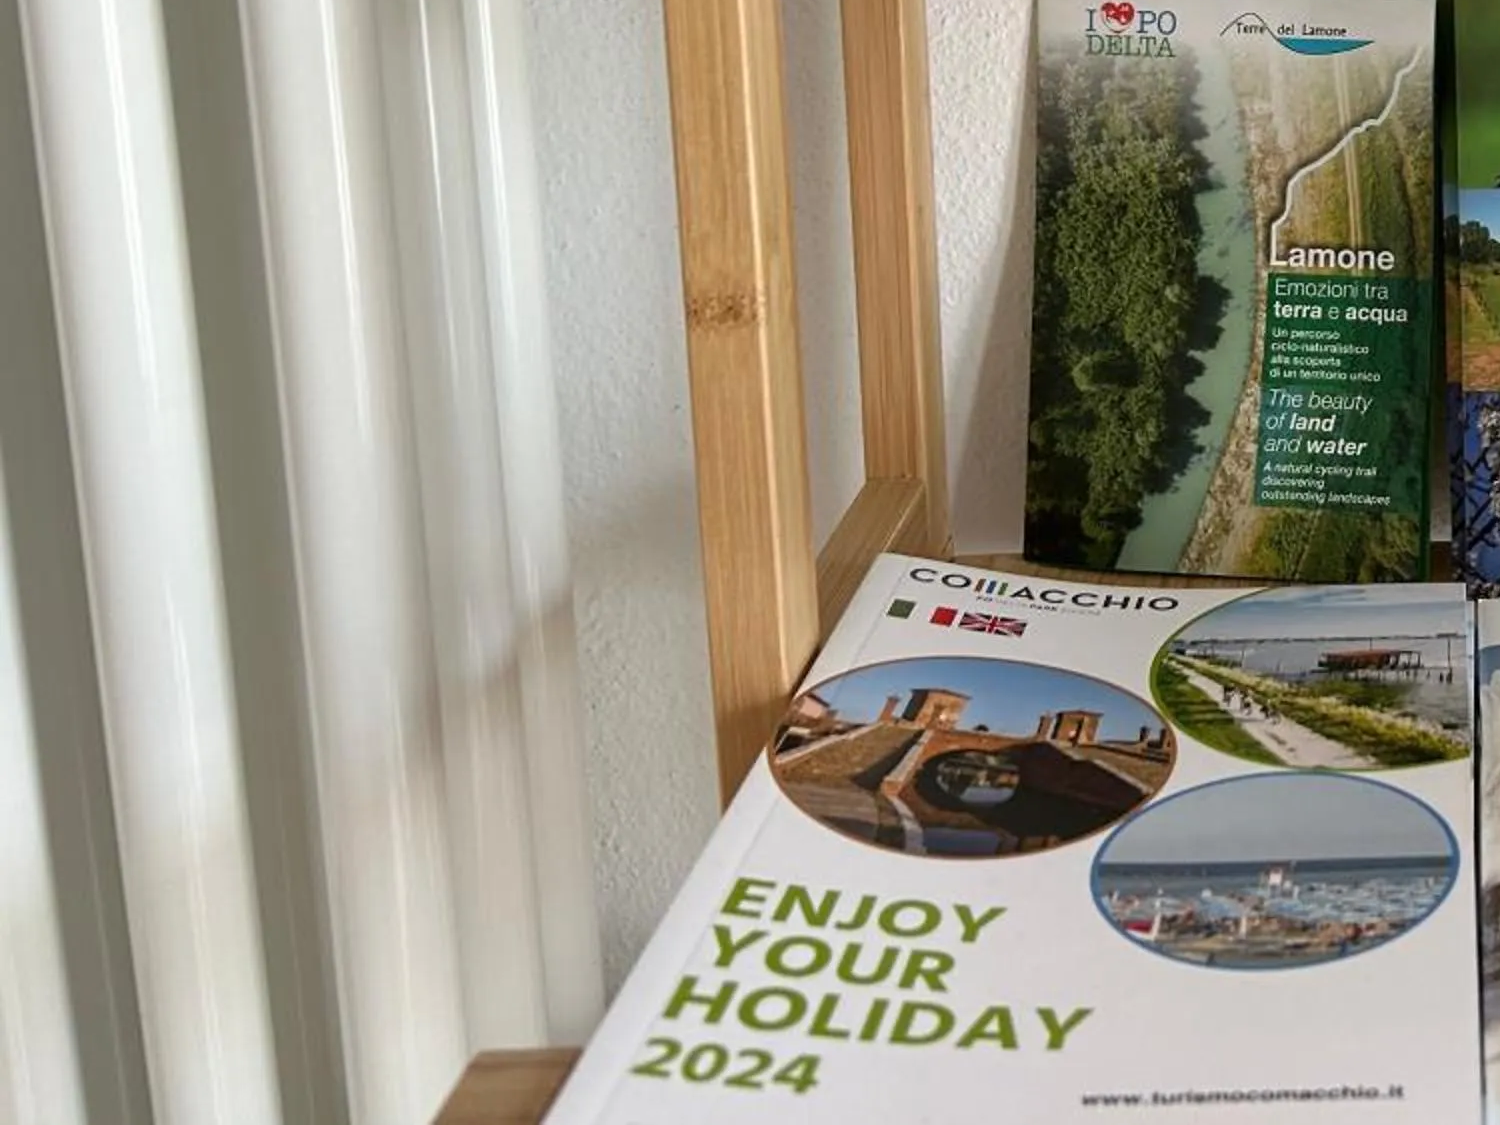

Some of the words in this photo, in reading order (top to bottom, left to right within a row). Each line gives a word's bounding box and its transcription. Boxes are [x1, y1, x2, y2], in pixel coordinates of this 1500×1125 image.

[1085, 9, 1096, 33] I
[1136, 10, 1178, 36] PO
[1277, 23, 1295, 36] del
[1302, 23, 1347, 36] Lamone
[1085, 35, 1176, 58] DELTA
[1270, 237, 1395, 271] Lamone
[1275, 278, 1359, 299] Emozioni
[1365, 282, 1389, 300] tra
[1273, 301, 1322, 319] terra
[1328, 306, 1340, 320] e
[1345, 306, 1408, 325] acqua
[1290, 328, 1341, 341] percorso
[1269, 367, 1281, 378] di
[1283, 369, 1297, 379] un
[1269, 389, 1304, 408] The
[1307, 390, 1374, 415] beauty
[1265, 412, 1289, 430] of
[1289, 412, 1337, 432] land
[1264, 435, 1303, 454] and
[1306, 438, 1368, 456] water
[1273, 462, 1313, 474] natural
[719, 876, 1007, 944] ENJOY
[711, 924, 956, 993] YOUR
[662, 976, 1094, 1053] HOLIDAY
[630, 1037, 822, 1095] 2024
[1081, 1083, 1405, 1107] www.turismocomacchio.it
